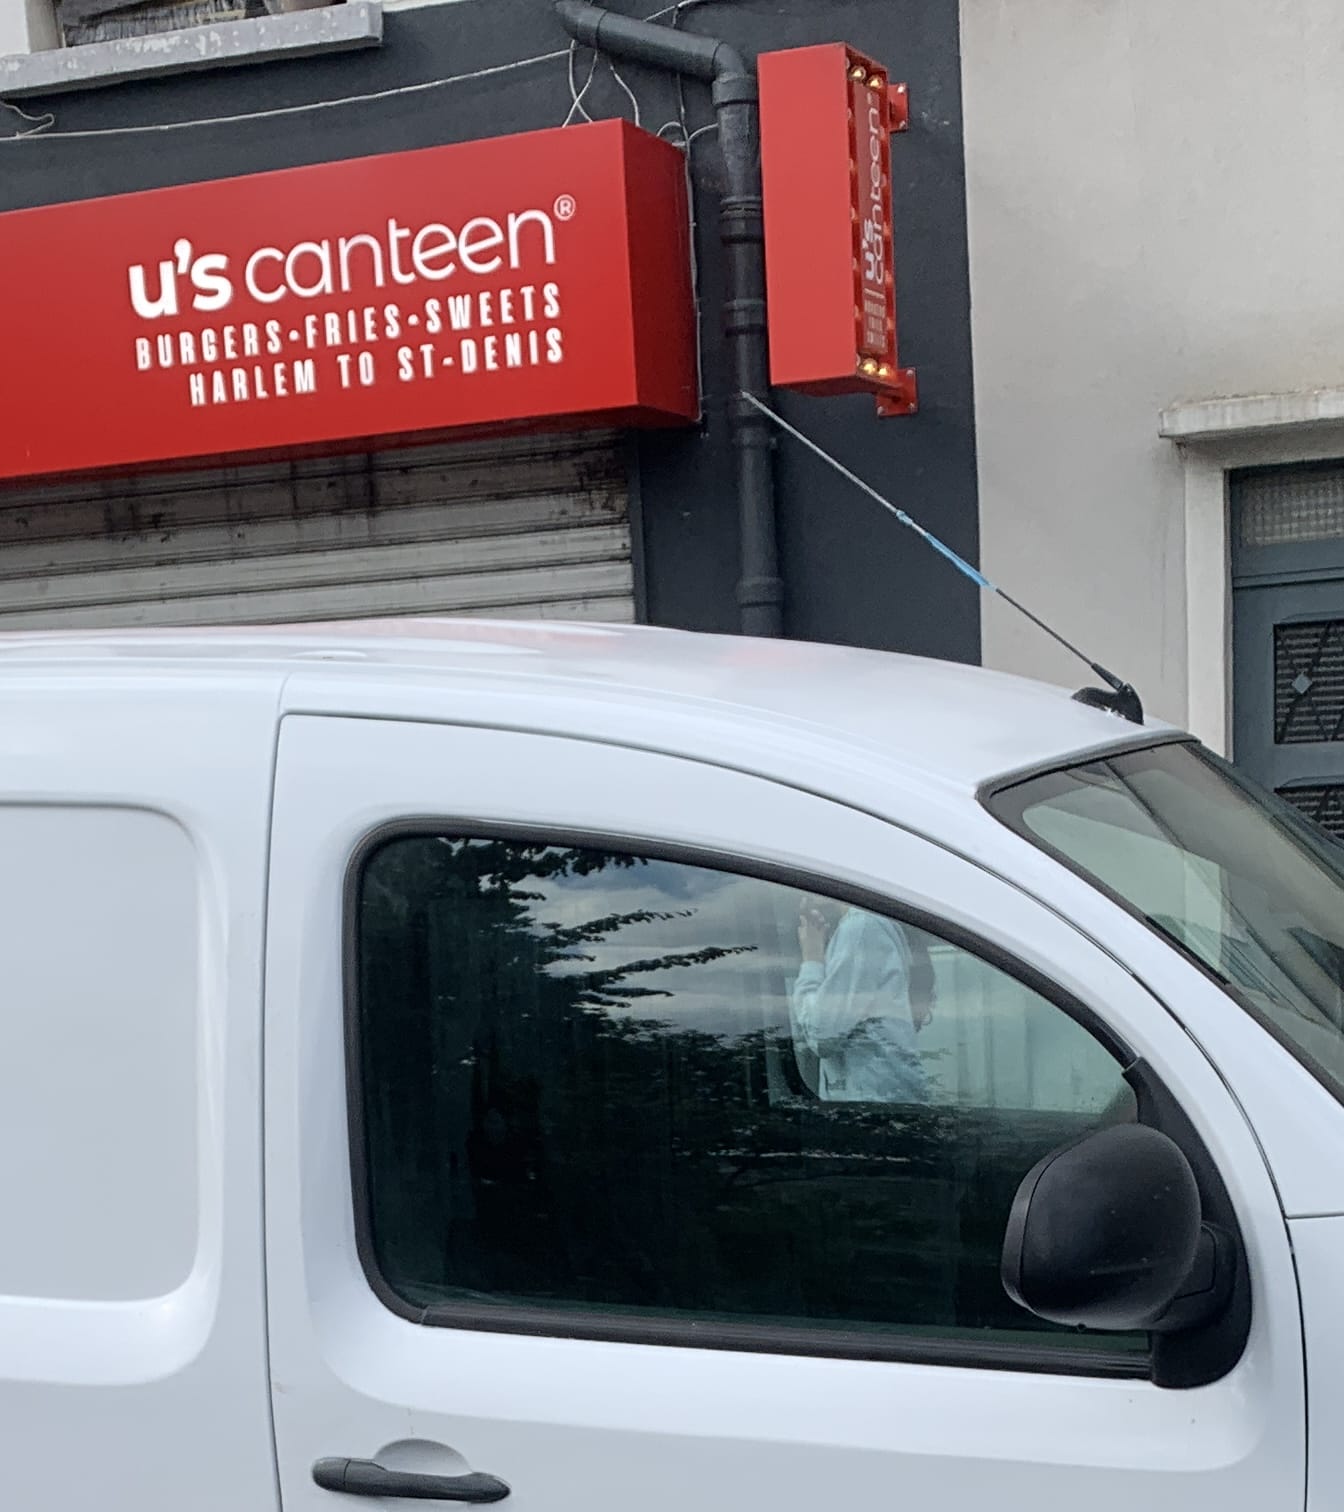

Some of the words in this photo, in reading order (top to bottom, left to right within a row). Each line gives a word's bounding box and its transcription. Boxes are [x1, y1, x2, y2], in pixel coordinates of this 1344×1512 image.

[129, 238, 233, 319] u's
[190, 359, 317, 407] HARLEM
[337, 351, 375, 388] TO
[397, 328, 563, 382] ST-DENIS
